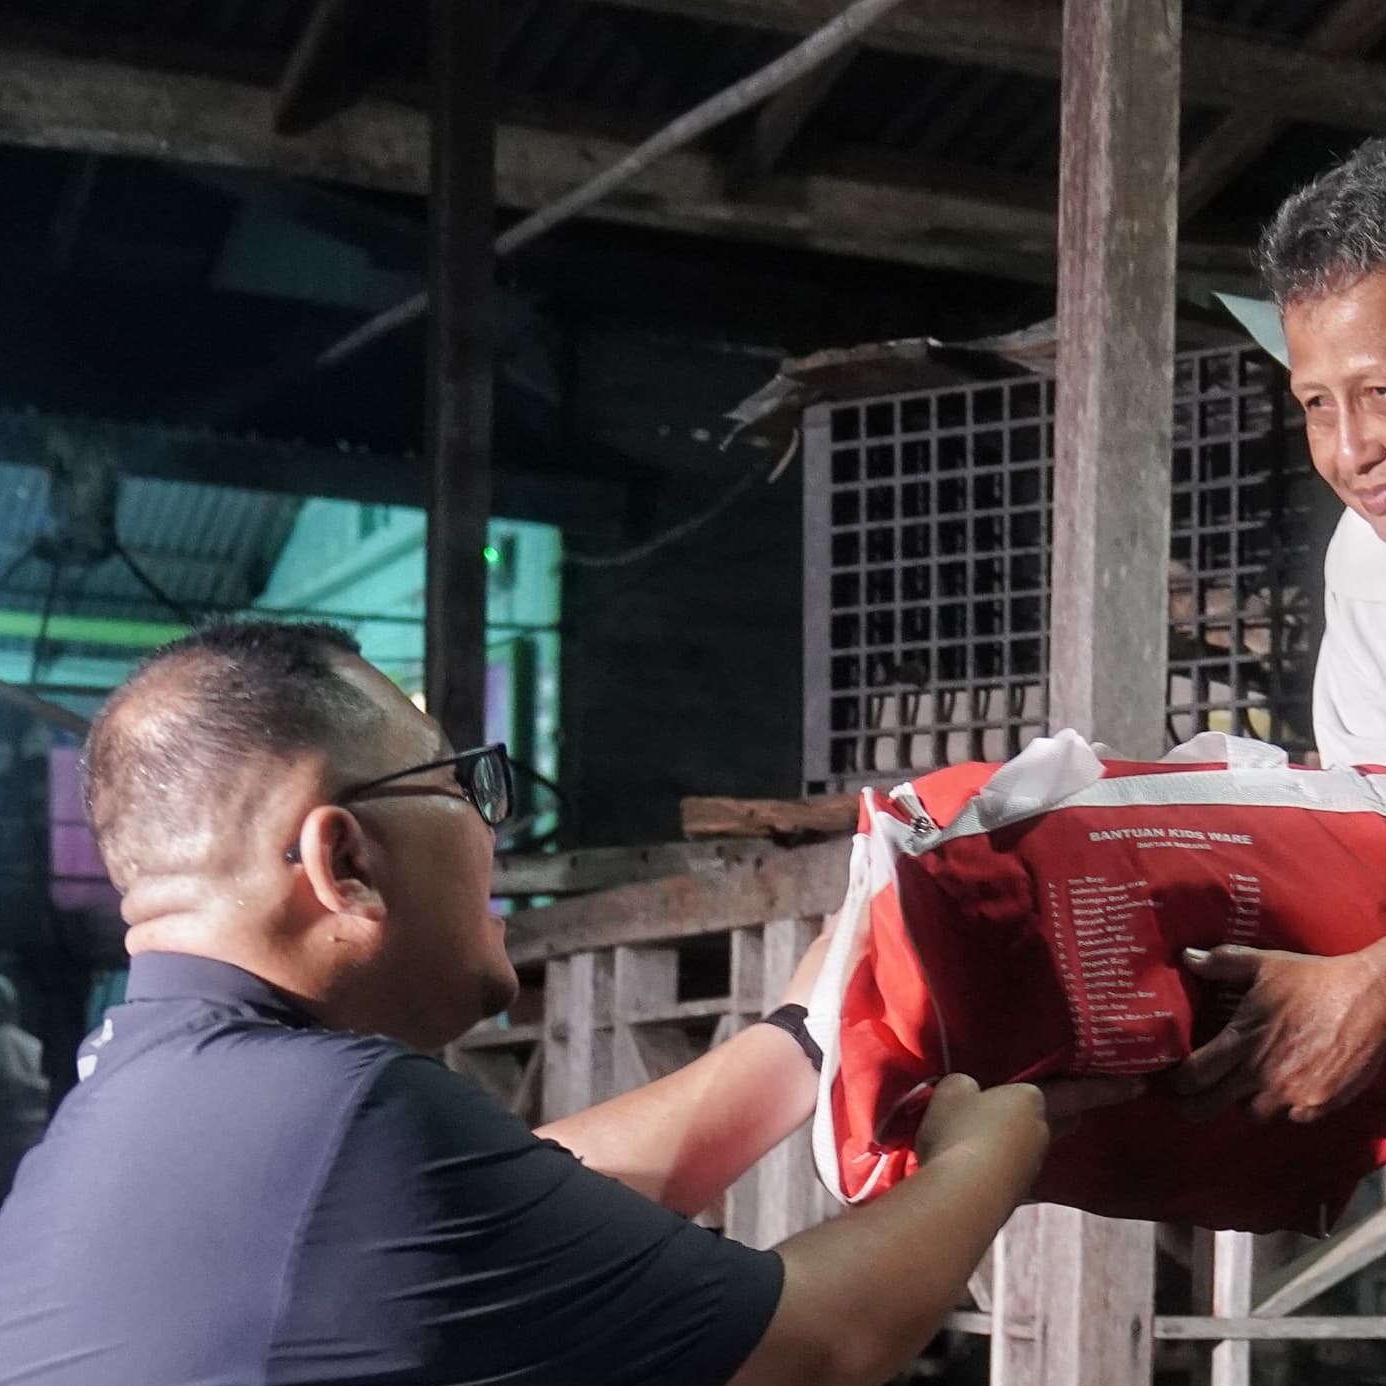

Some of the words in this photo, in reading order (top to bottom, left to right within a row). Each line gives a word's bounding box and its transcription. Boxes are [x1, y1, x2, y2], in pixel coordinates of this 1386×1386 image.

[1088, 828, 1165, 842] BANTUAN
[1167, 828, 1207, 841] KIDS
[1207, 831, 1254, 845] WARE
